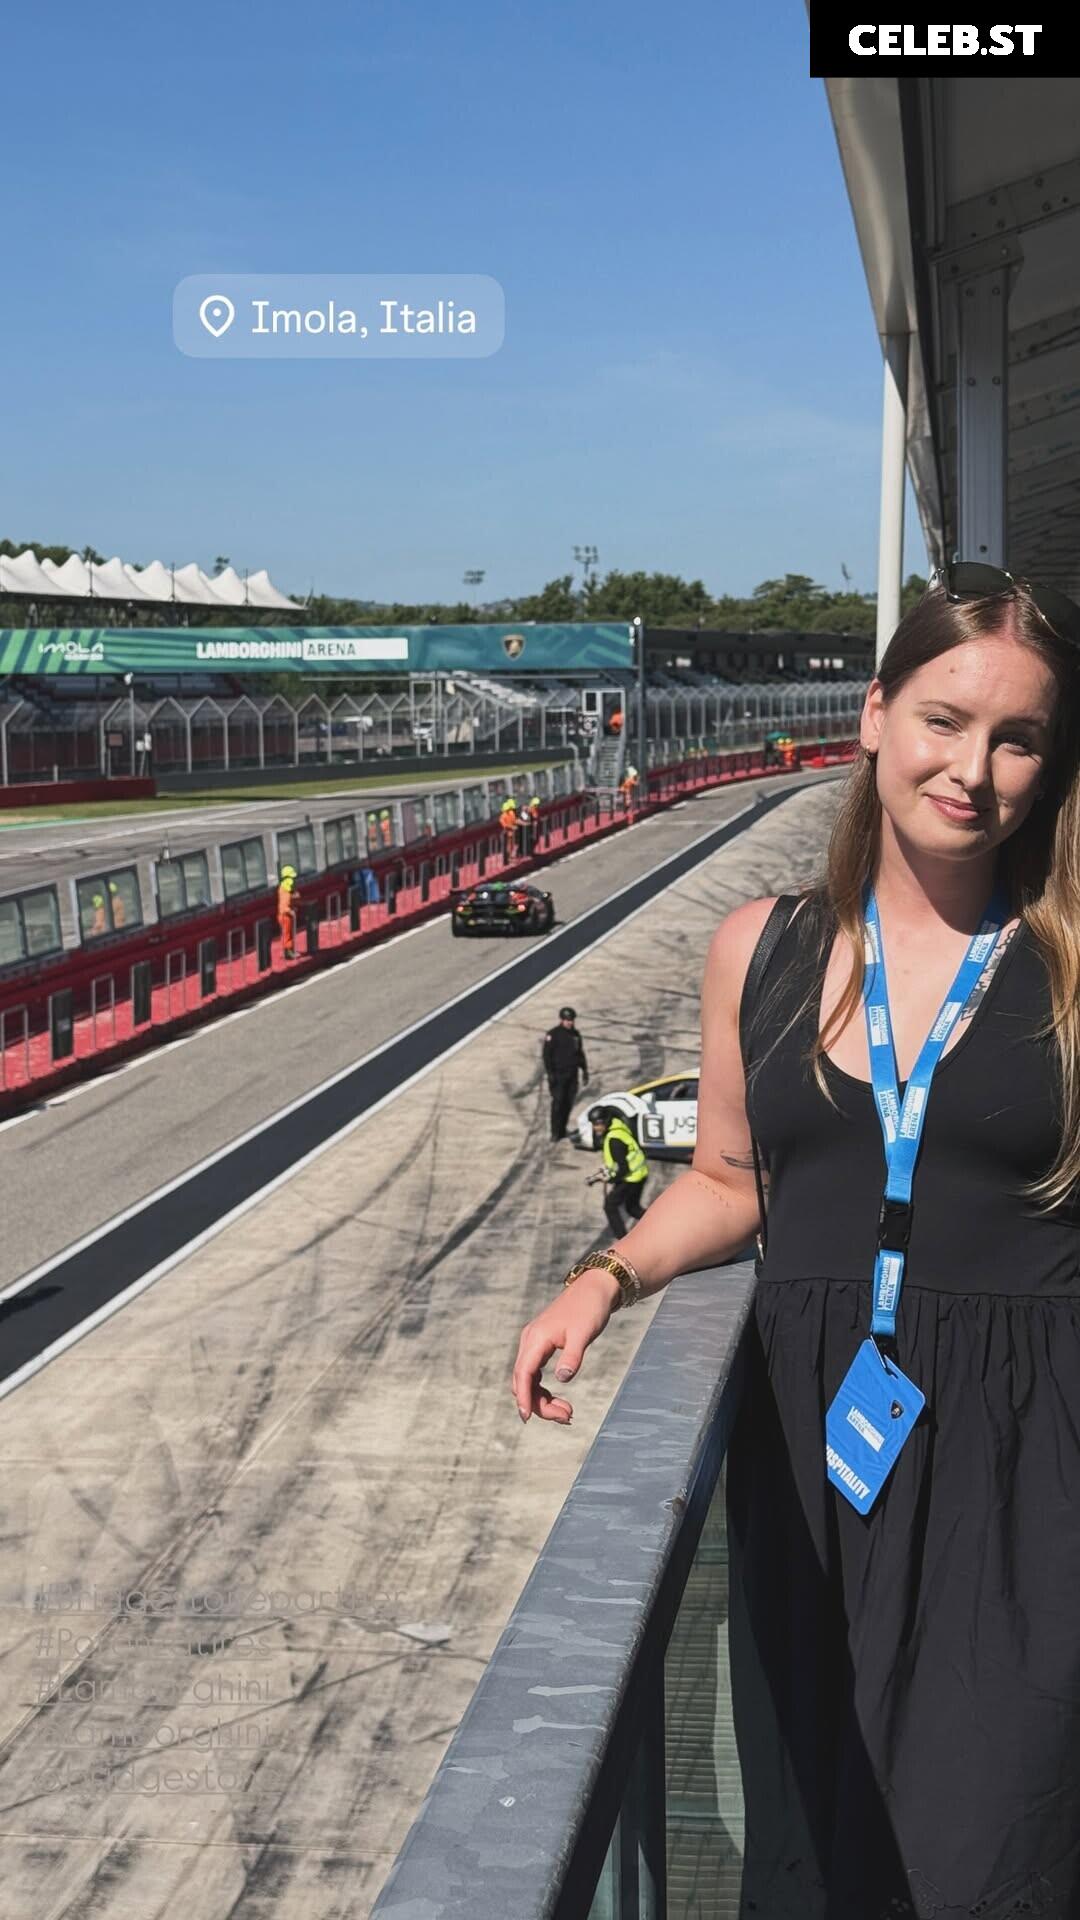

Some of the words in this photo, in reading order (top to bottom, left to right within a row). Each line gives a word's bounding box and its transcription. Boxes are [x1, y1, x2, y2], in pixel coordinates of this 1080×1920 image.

[196, 641, 302, 659] LAMBORGHINI
[306, 643, 357, 657] ARENA
[879, 1092, 891, 1119] ARENA
[647, 1119, 661, 1138] 6
[908, 1111, 920, 1138] ARENA
[885, 1283, 895, 1309] ARENA
